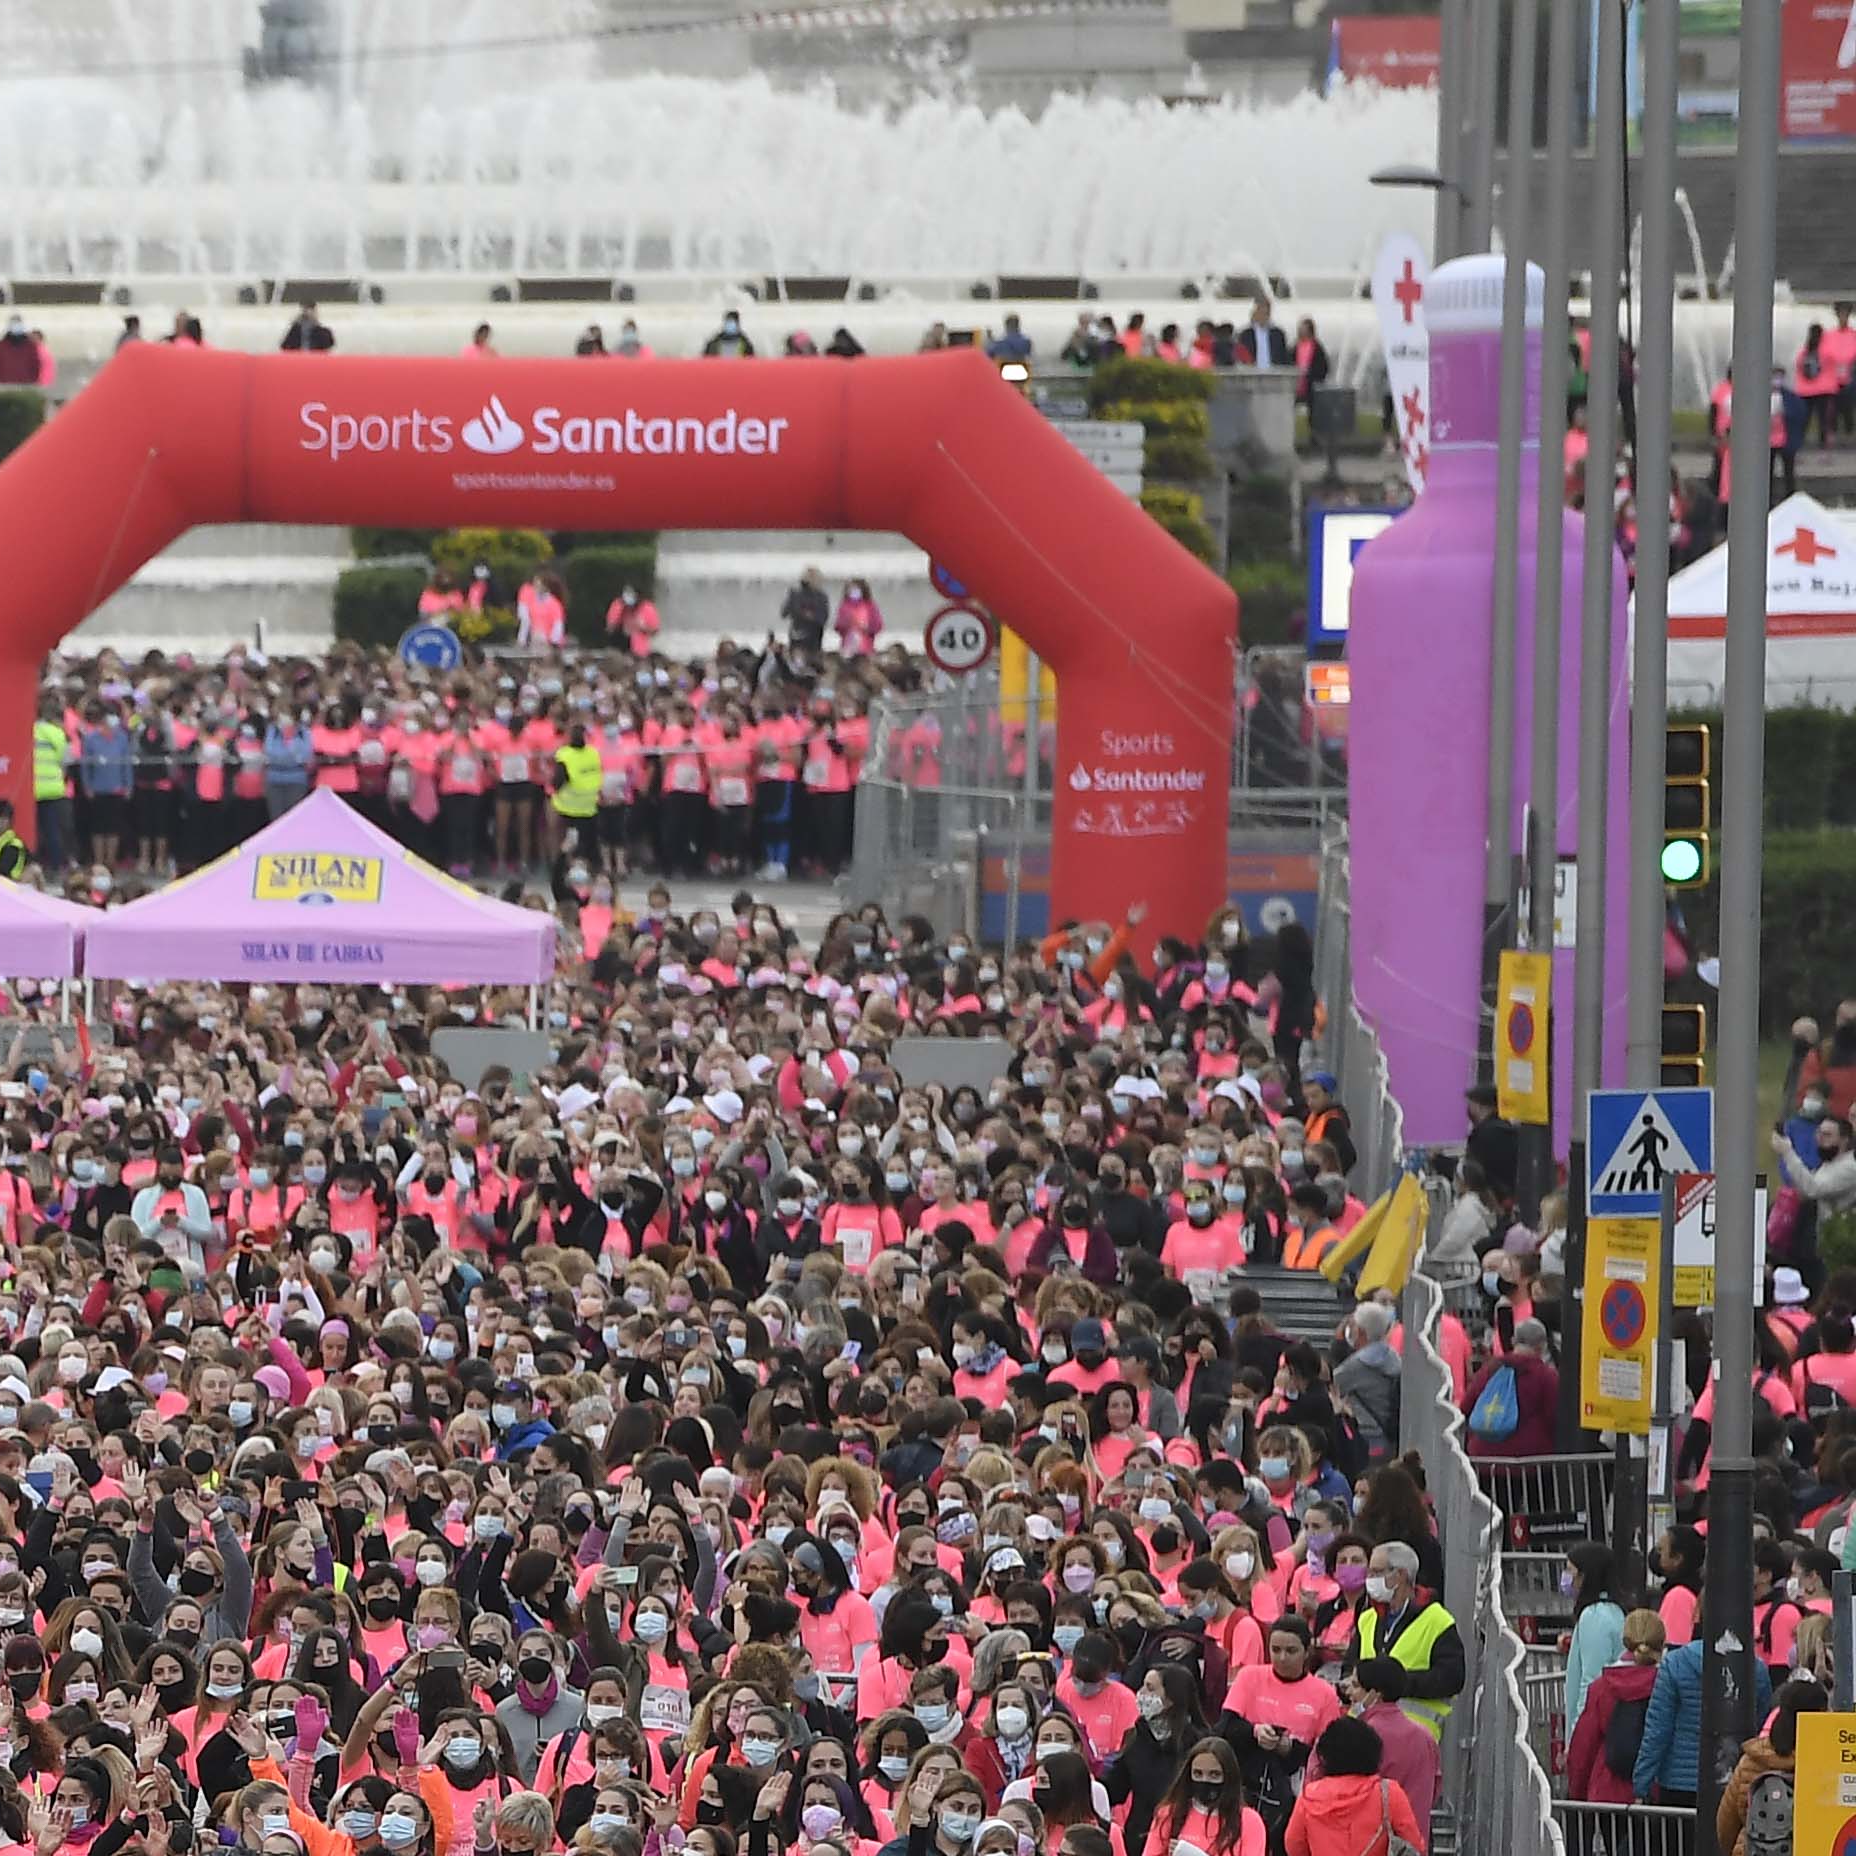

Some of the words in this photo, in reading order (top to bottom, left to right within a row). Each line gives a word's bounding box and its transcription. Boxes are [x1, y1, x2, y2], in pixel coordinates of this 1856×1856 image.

[299, 401, 454, 462] Sports
[531, 407, 789, 456] Santander
[937, 628, 980, 651] 40
[1101, 730, 1174, 758] Sports
[1093, 767, 1206, 792] Santander
[1838, 1730, 1856, 1744] Se
[1841, 1749, 1856, 1763] Ex
